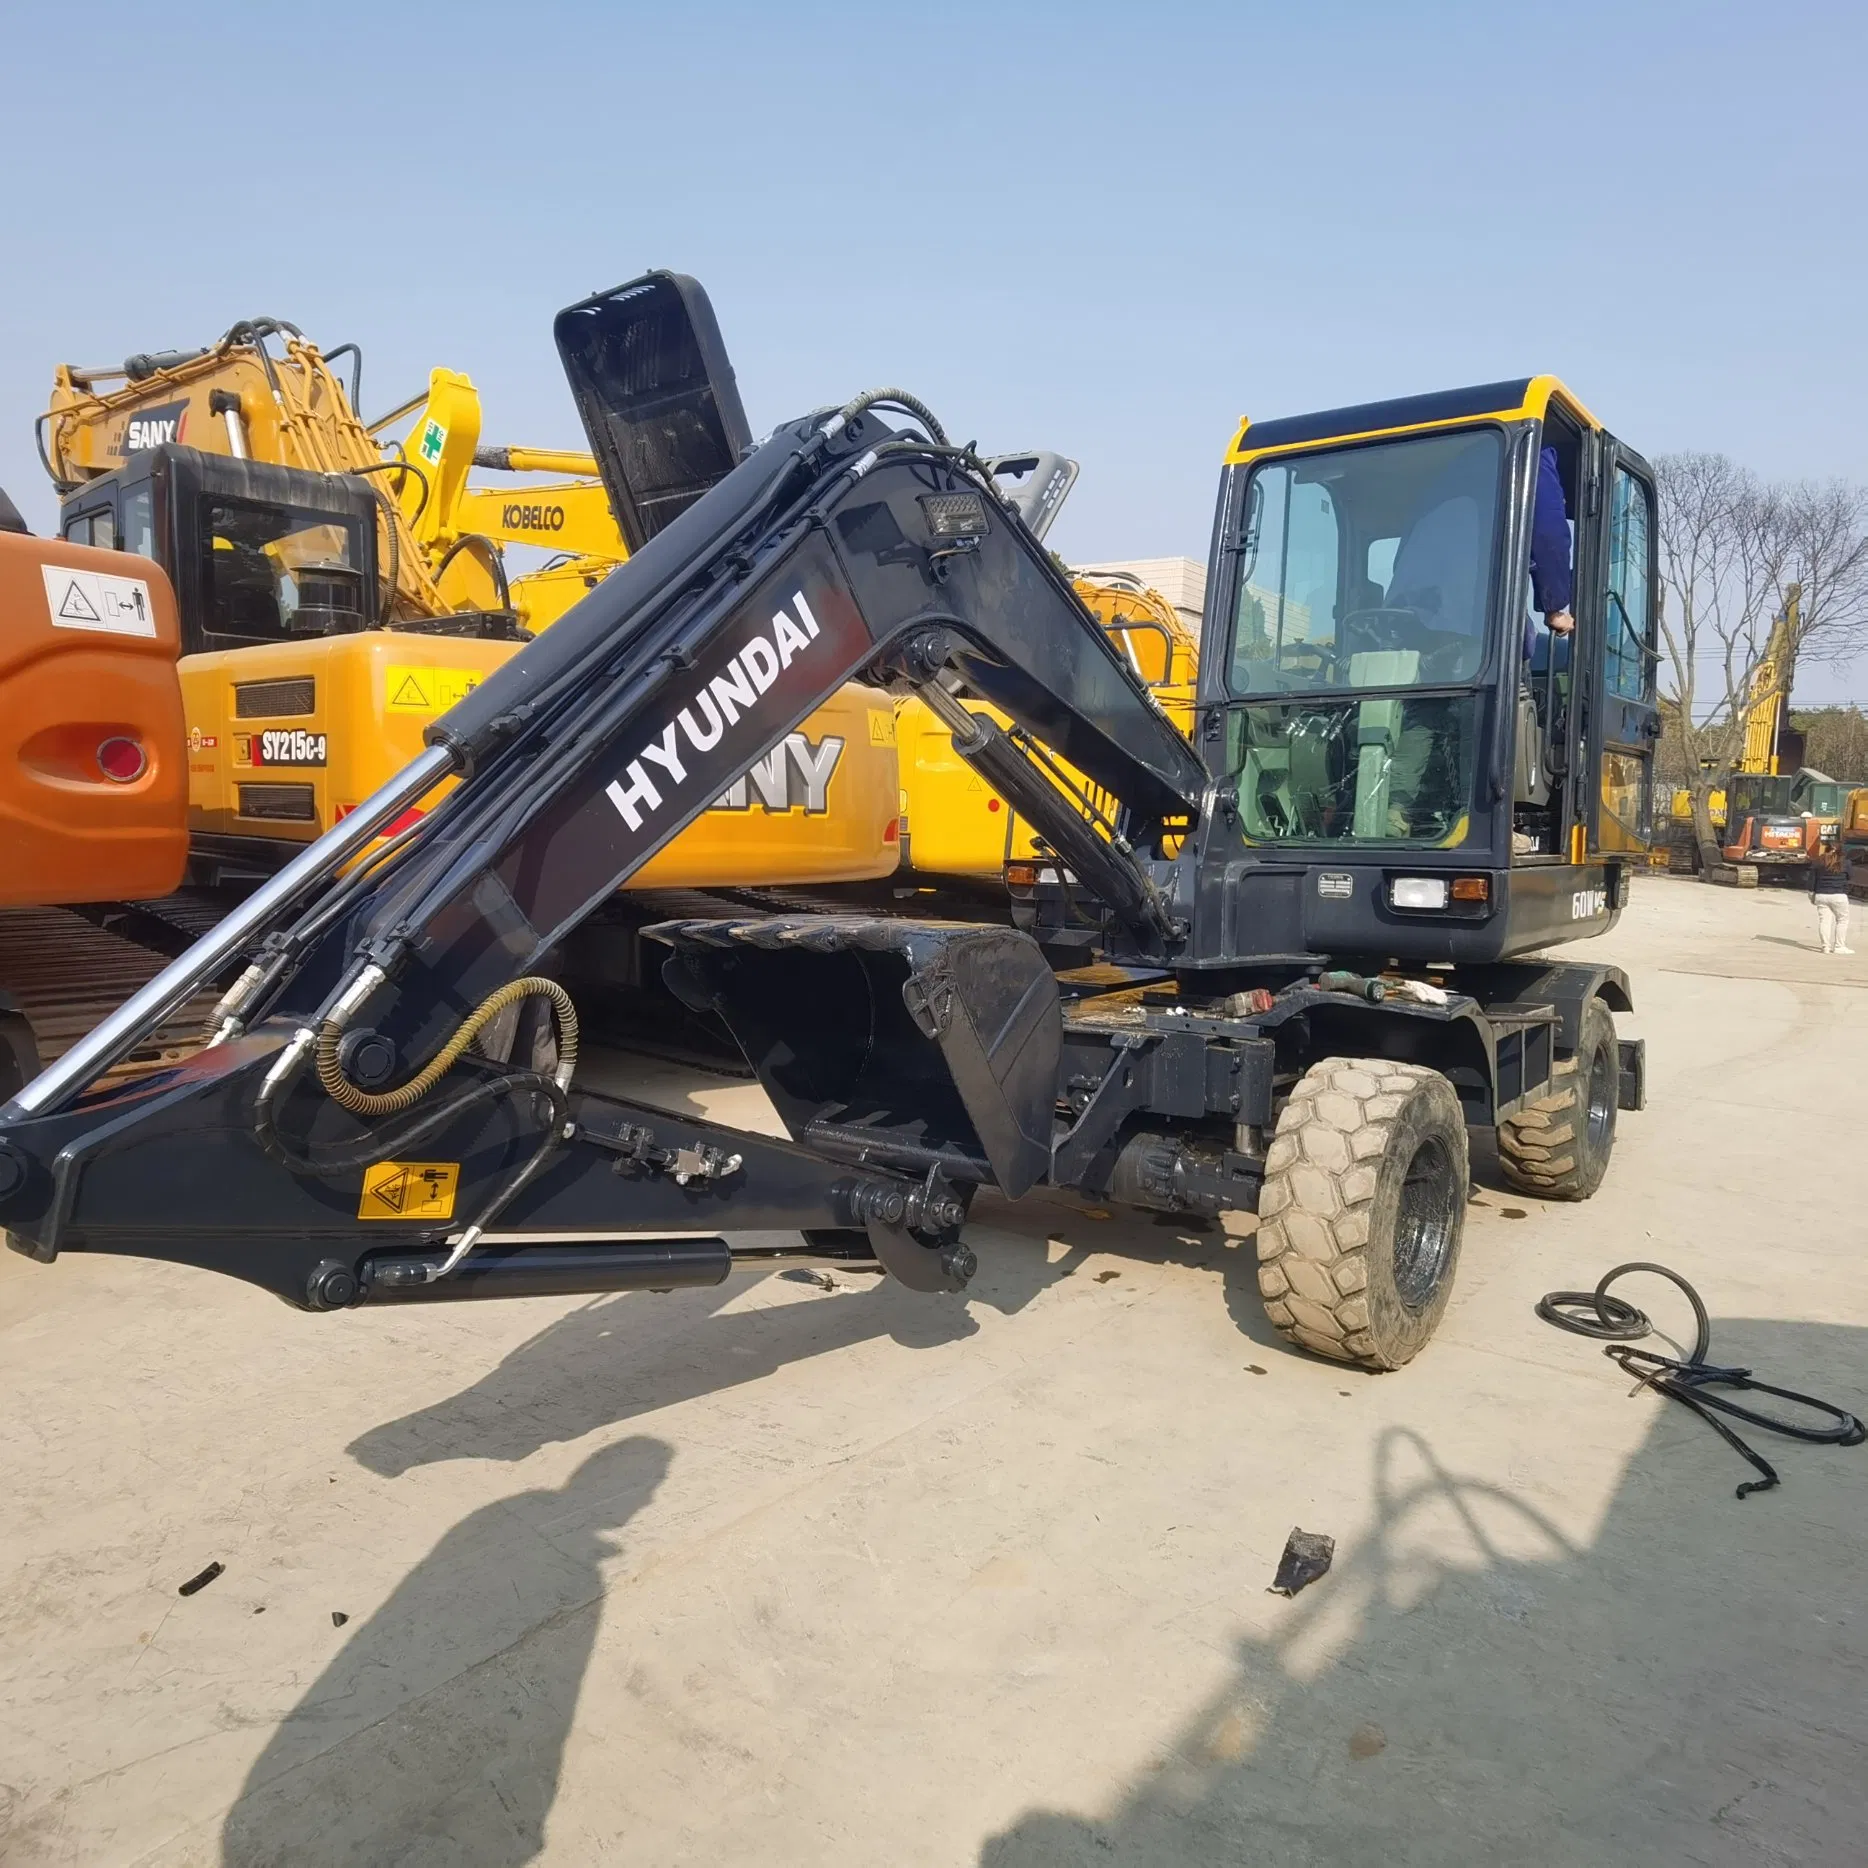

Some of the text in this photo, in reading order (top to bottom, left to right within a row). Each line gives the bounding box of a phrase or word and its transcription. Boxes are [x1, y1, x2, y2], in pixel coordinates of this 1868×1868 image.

[128, 420, 175, 449] SANY
[502, 504, 565, 531] KOBELCO
[605, 590, 821, 833] HYUNDAI
[262, 730, 326, 760] SY215C-9
[1820, 824, 1839, 835] CAT
